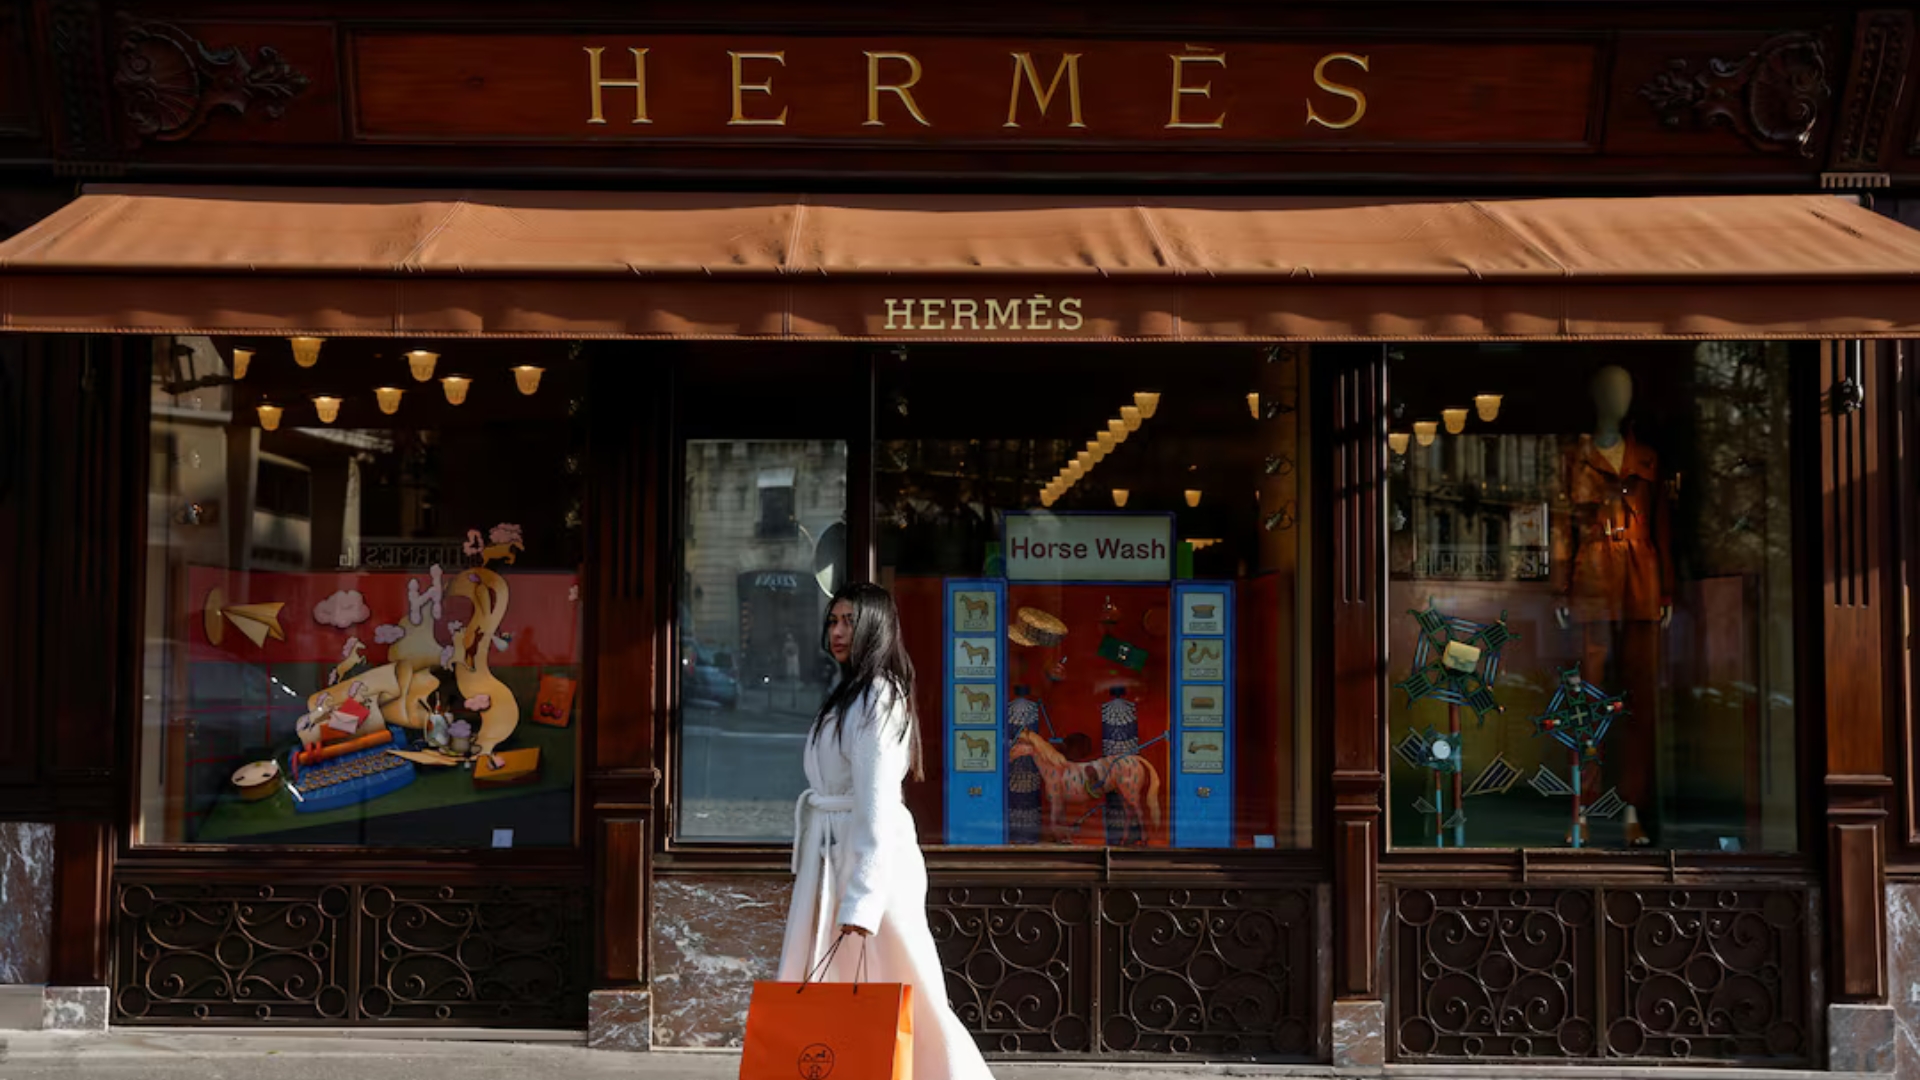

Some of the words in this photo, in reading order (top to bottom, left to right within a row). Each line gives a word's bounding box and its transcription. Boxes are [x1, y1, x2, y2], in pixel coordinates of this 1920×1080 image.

[884, 293, 1084, 330] HERMÈS
[1011, 537, 1088, 559] Horse
[1095, 538, 1165, 559] Wash
